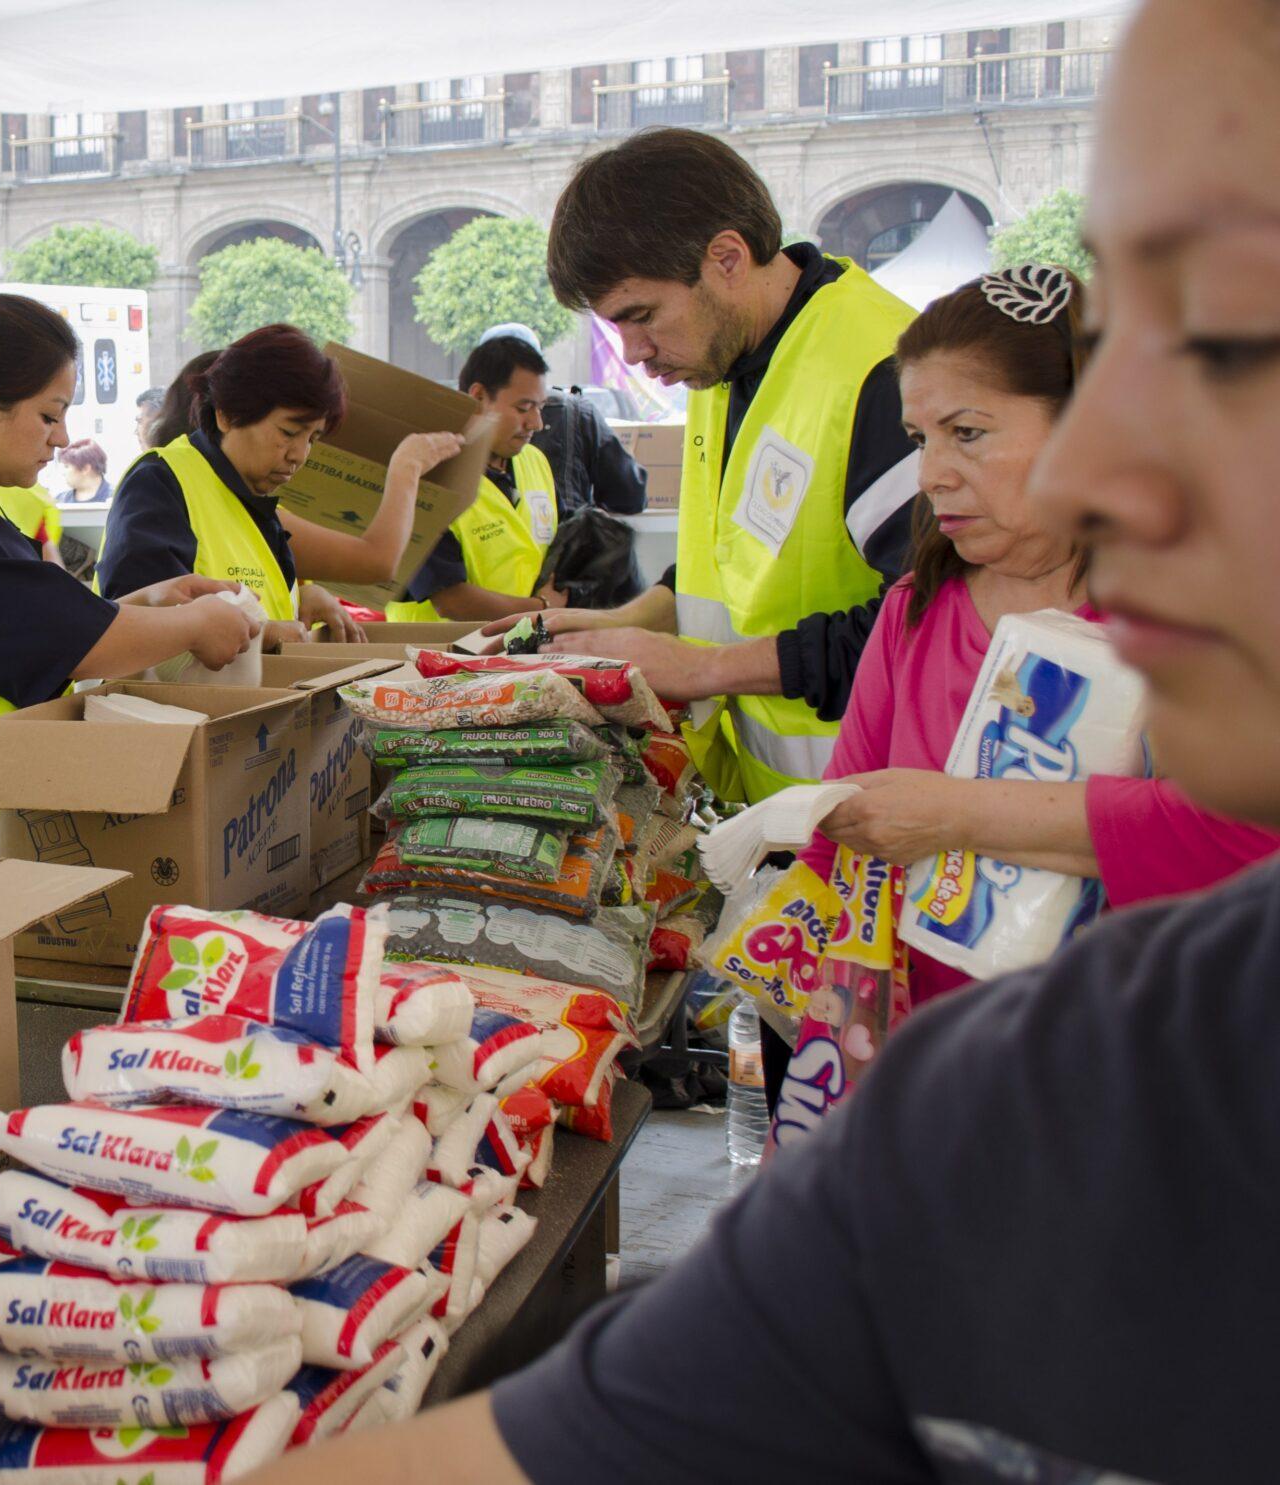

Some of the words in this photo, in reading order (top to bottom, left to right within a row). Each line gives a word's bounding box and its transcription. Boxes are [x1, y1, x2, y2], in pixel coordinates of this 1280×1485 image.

[494, 731, 530, 741] NEGRO
[537, 730, 555, 739] 900
[223, 747, 298, 879] Patrona
[407, 801, 419, 811] EL
[423, 798, 461, 811] FRESNO
[289, 992, 302, 1015] Sal
[108, 1048, 150, 1071] Sal
[148, 1049, 224, 1077] Klara
[57, 1126, 102, 1156] Sal
[100, 1133, 175, 1173] Klara
[17, 1197, 63, 1232] Sal
[53, 1214, 118, 1247] Klara
[5, 1298, 49, 1327] Sal
[47, 1300, 117, 1330] Klara
[12, 1364, 54, 1391] Sal
[51, 1363, 126, 1391] Klara
